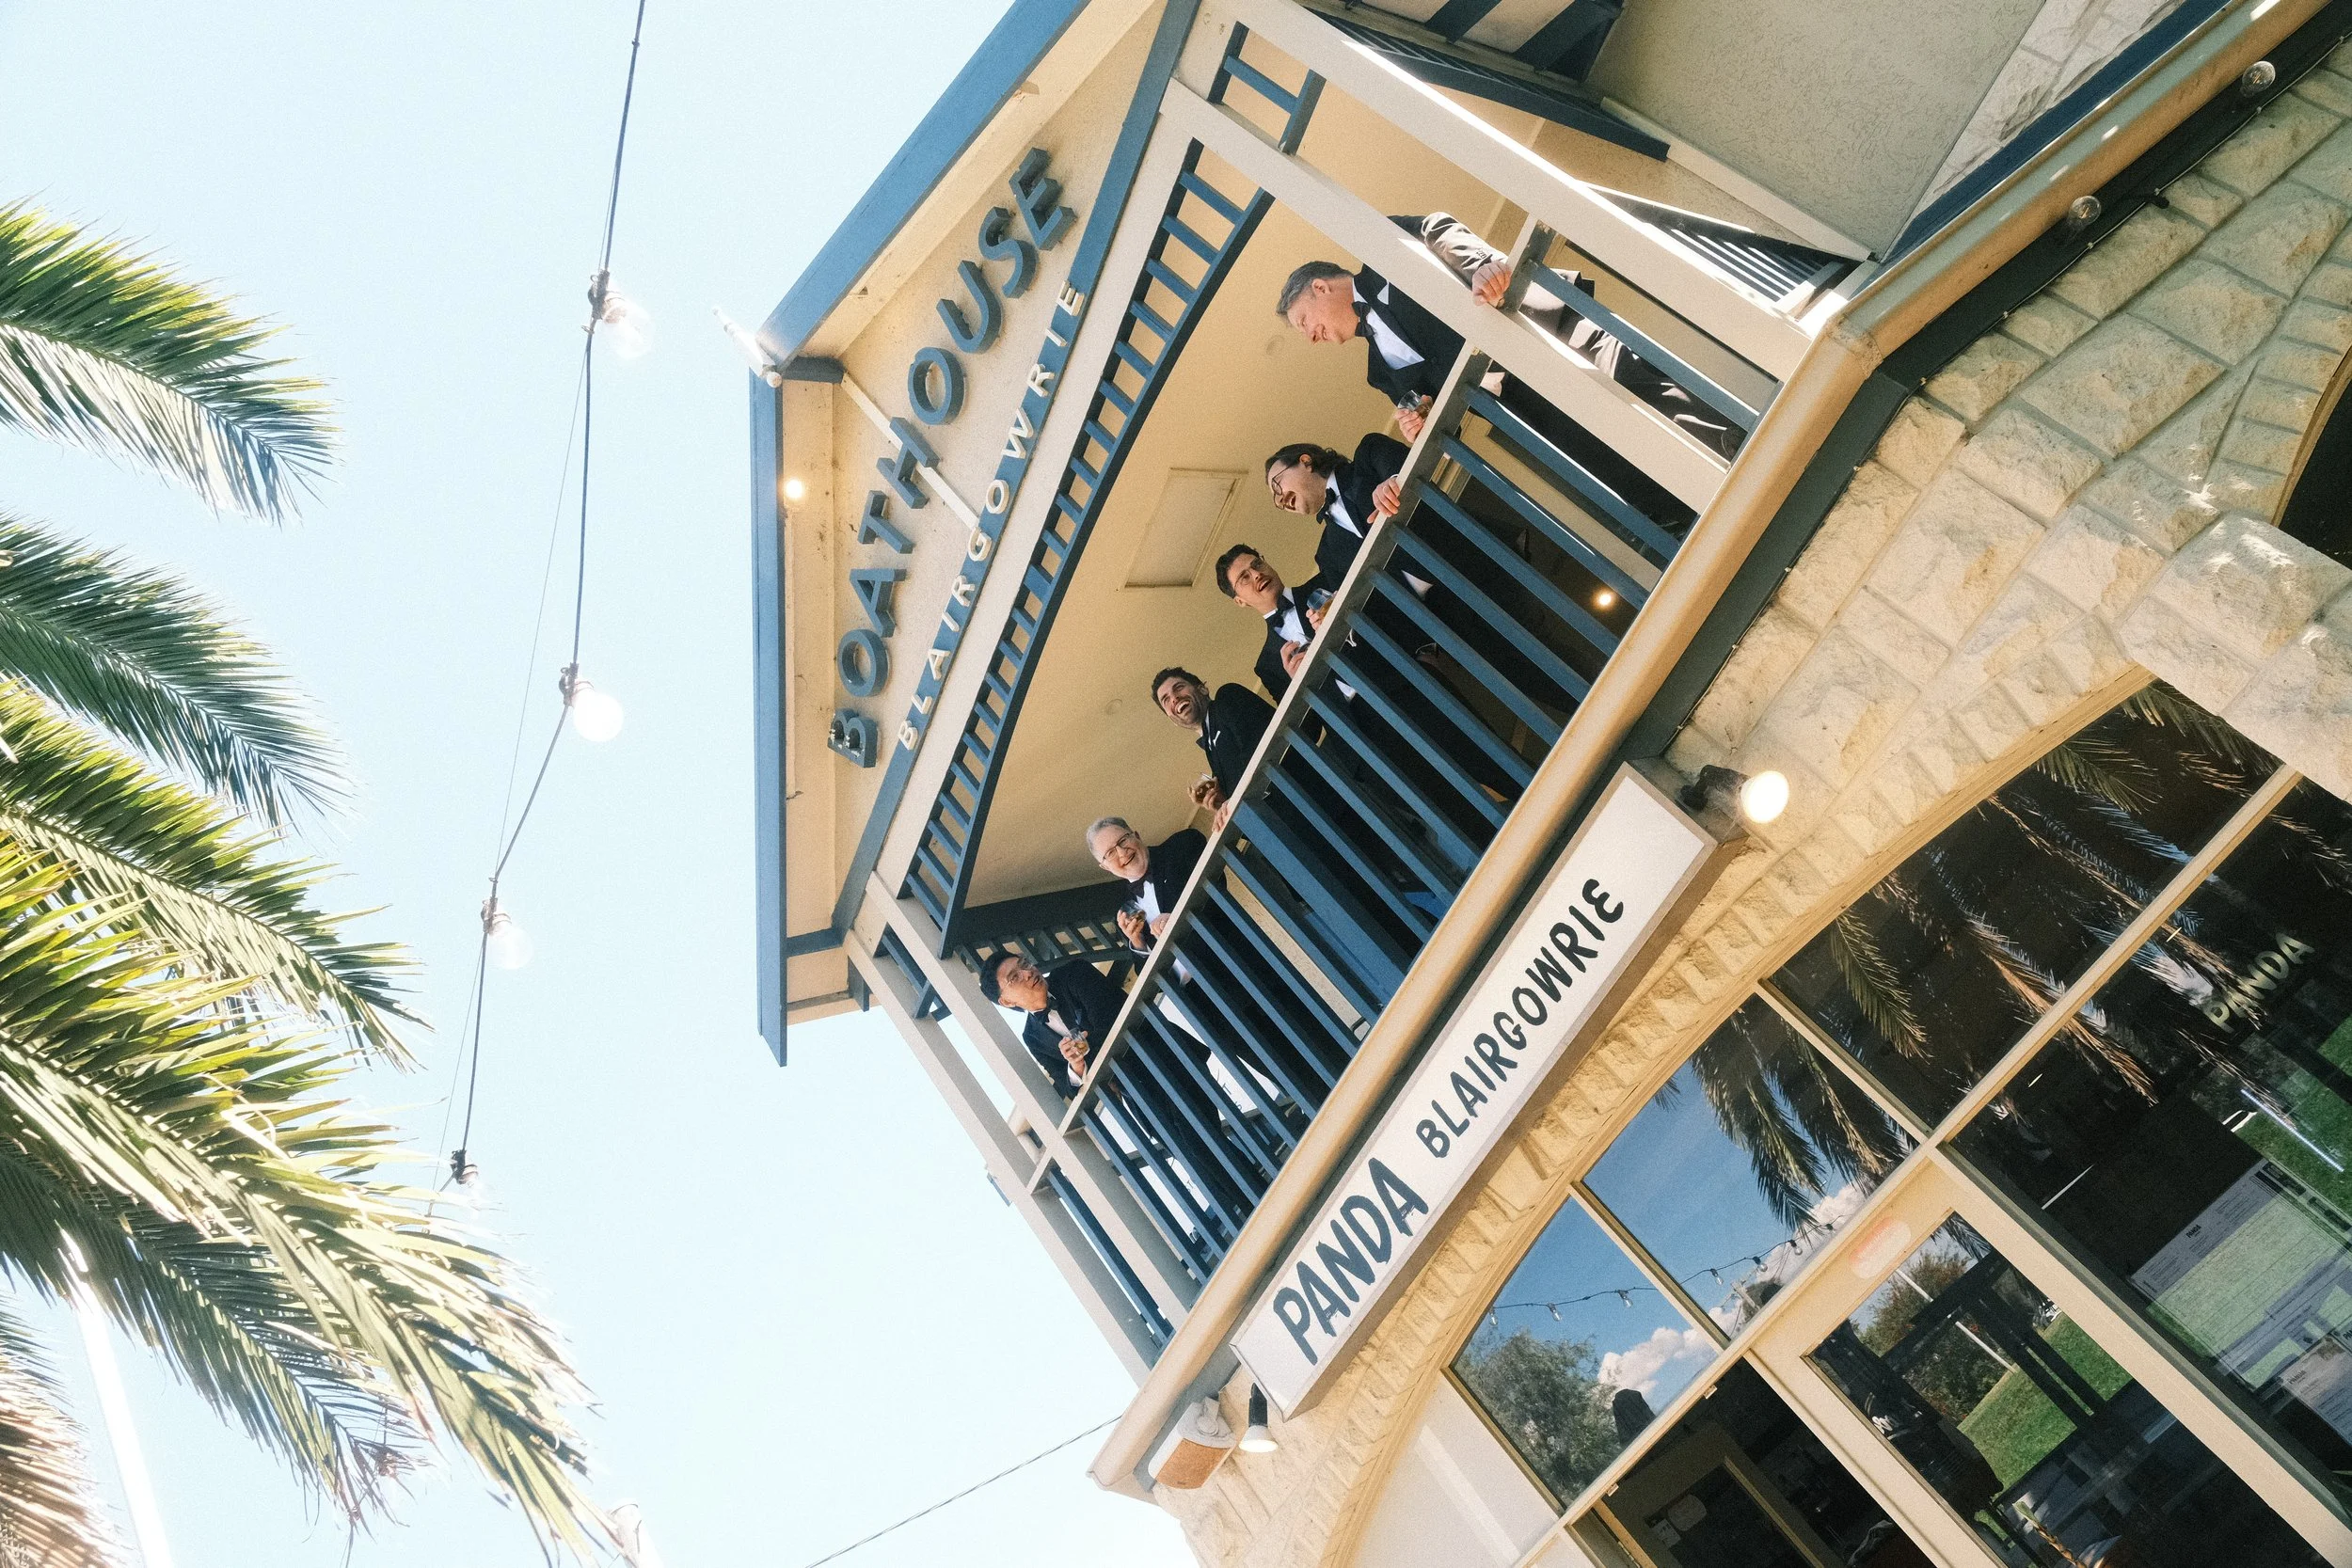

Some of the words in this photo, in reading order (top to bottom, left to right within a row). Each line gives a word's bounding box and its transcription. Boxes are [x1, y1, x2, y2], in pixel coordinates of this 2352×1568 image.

[827, 147, 1077, 768] BOATHOUSE
[898, 280, 1085, 752] BLAIRGOWRIE
[1272, 1156, 1430, 1366] PANDA
[1416, 878, 1625, 1159] BLAIRGOWRIE
[2204, 932, 2315, 1033] PANDA
